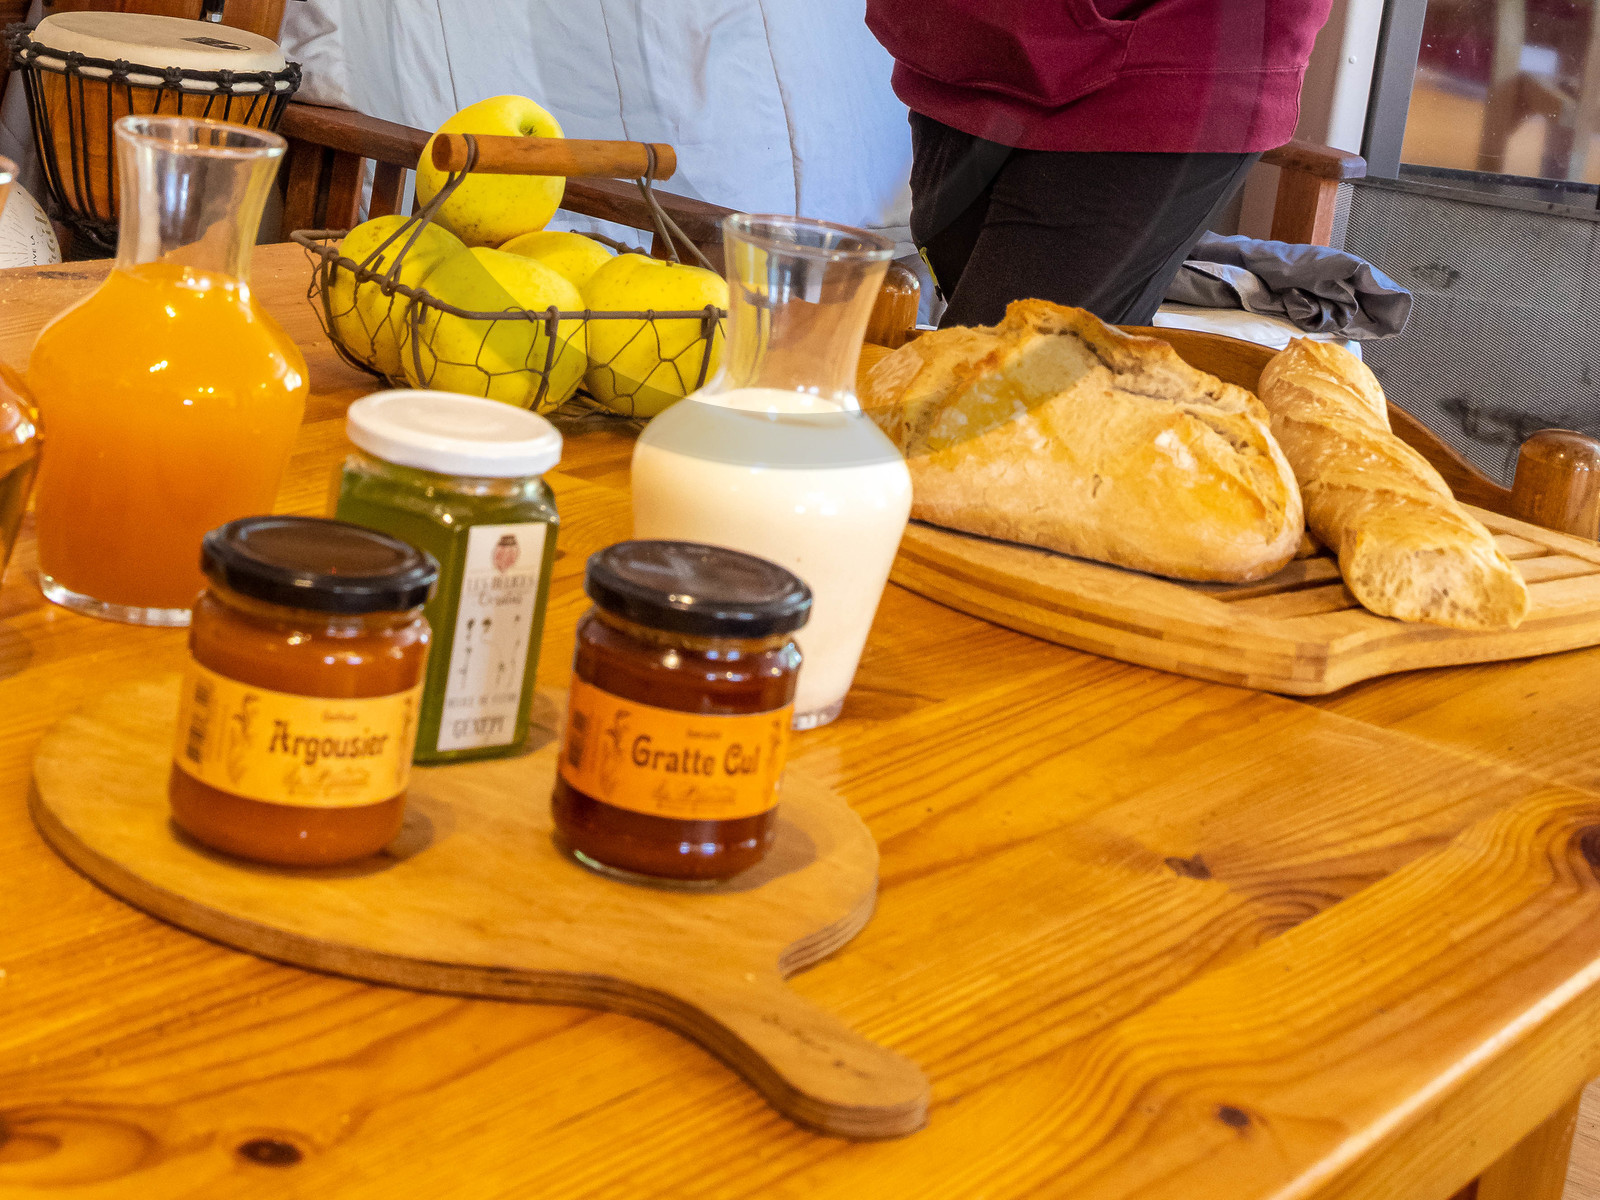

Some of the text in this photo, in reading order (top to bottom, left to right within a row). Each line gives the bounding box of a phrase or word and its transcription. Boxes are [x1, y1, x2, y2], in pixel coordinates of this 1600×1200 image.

[269, 719, 388, 766] Argousier
[632, 734, 761, 777] Gratte Cul
